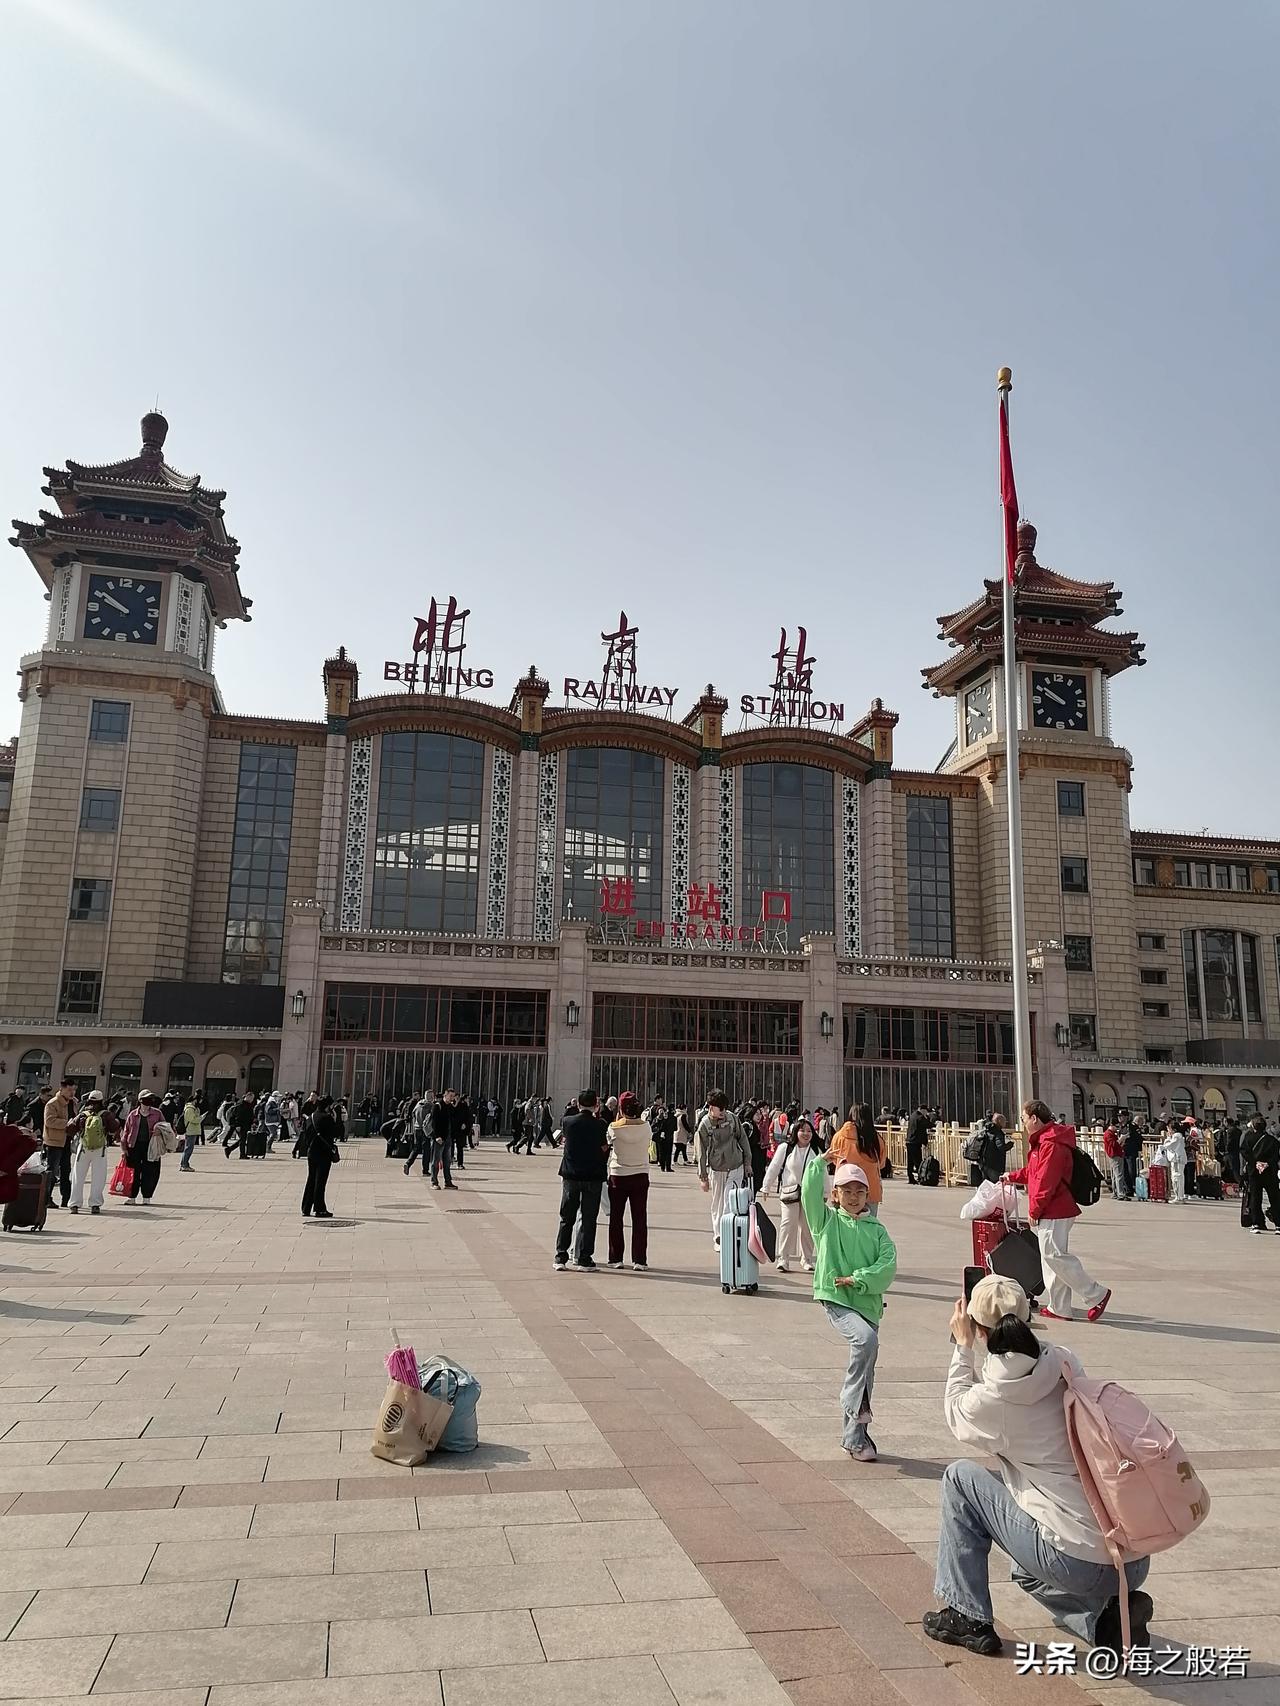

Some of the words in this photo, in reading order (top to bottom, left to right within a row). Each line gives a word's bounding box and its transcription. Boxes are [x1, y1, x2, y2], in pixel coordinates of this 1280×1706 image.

[119, 578, 133, 588] 12
[87, 602, 99, 612] 9
[147, 608, 159, 618] 3
[412, 596, 471, 654] 北
[115, 632, 127, 642] 6
[600, 610, 639, 678] 京
[1053, 674, 1064, 683] 12
[384, 661, 494, 688] BEIJING
[564, 678, 679, 705] RAILWAY
[740, 695, 844, 720] STATION
[1033, 695, 1042, 704] 9
[1077, 699, 1086, 708] 3
[1056, 721, 1065, 729] 6
[636, 920, 765, 942] ENTRANCE
